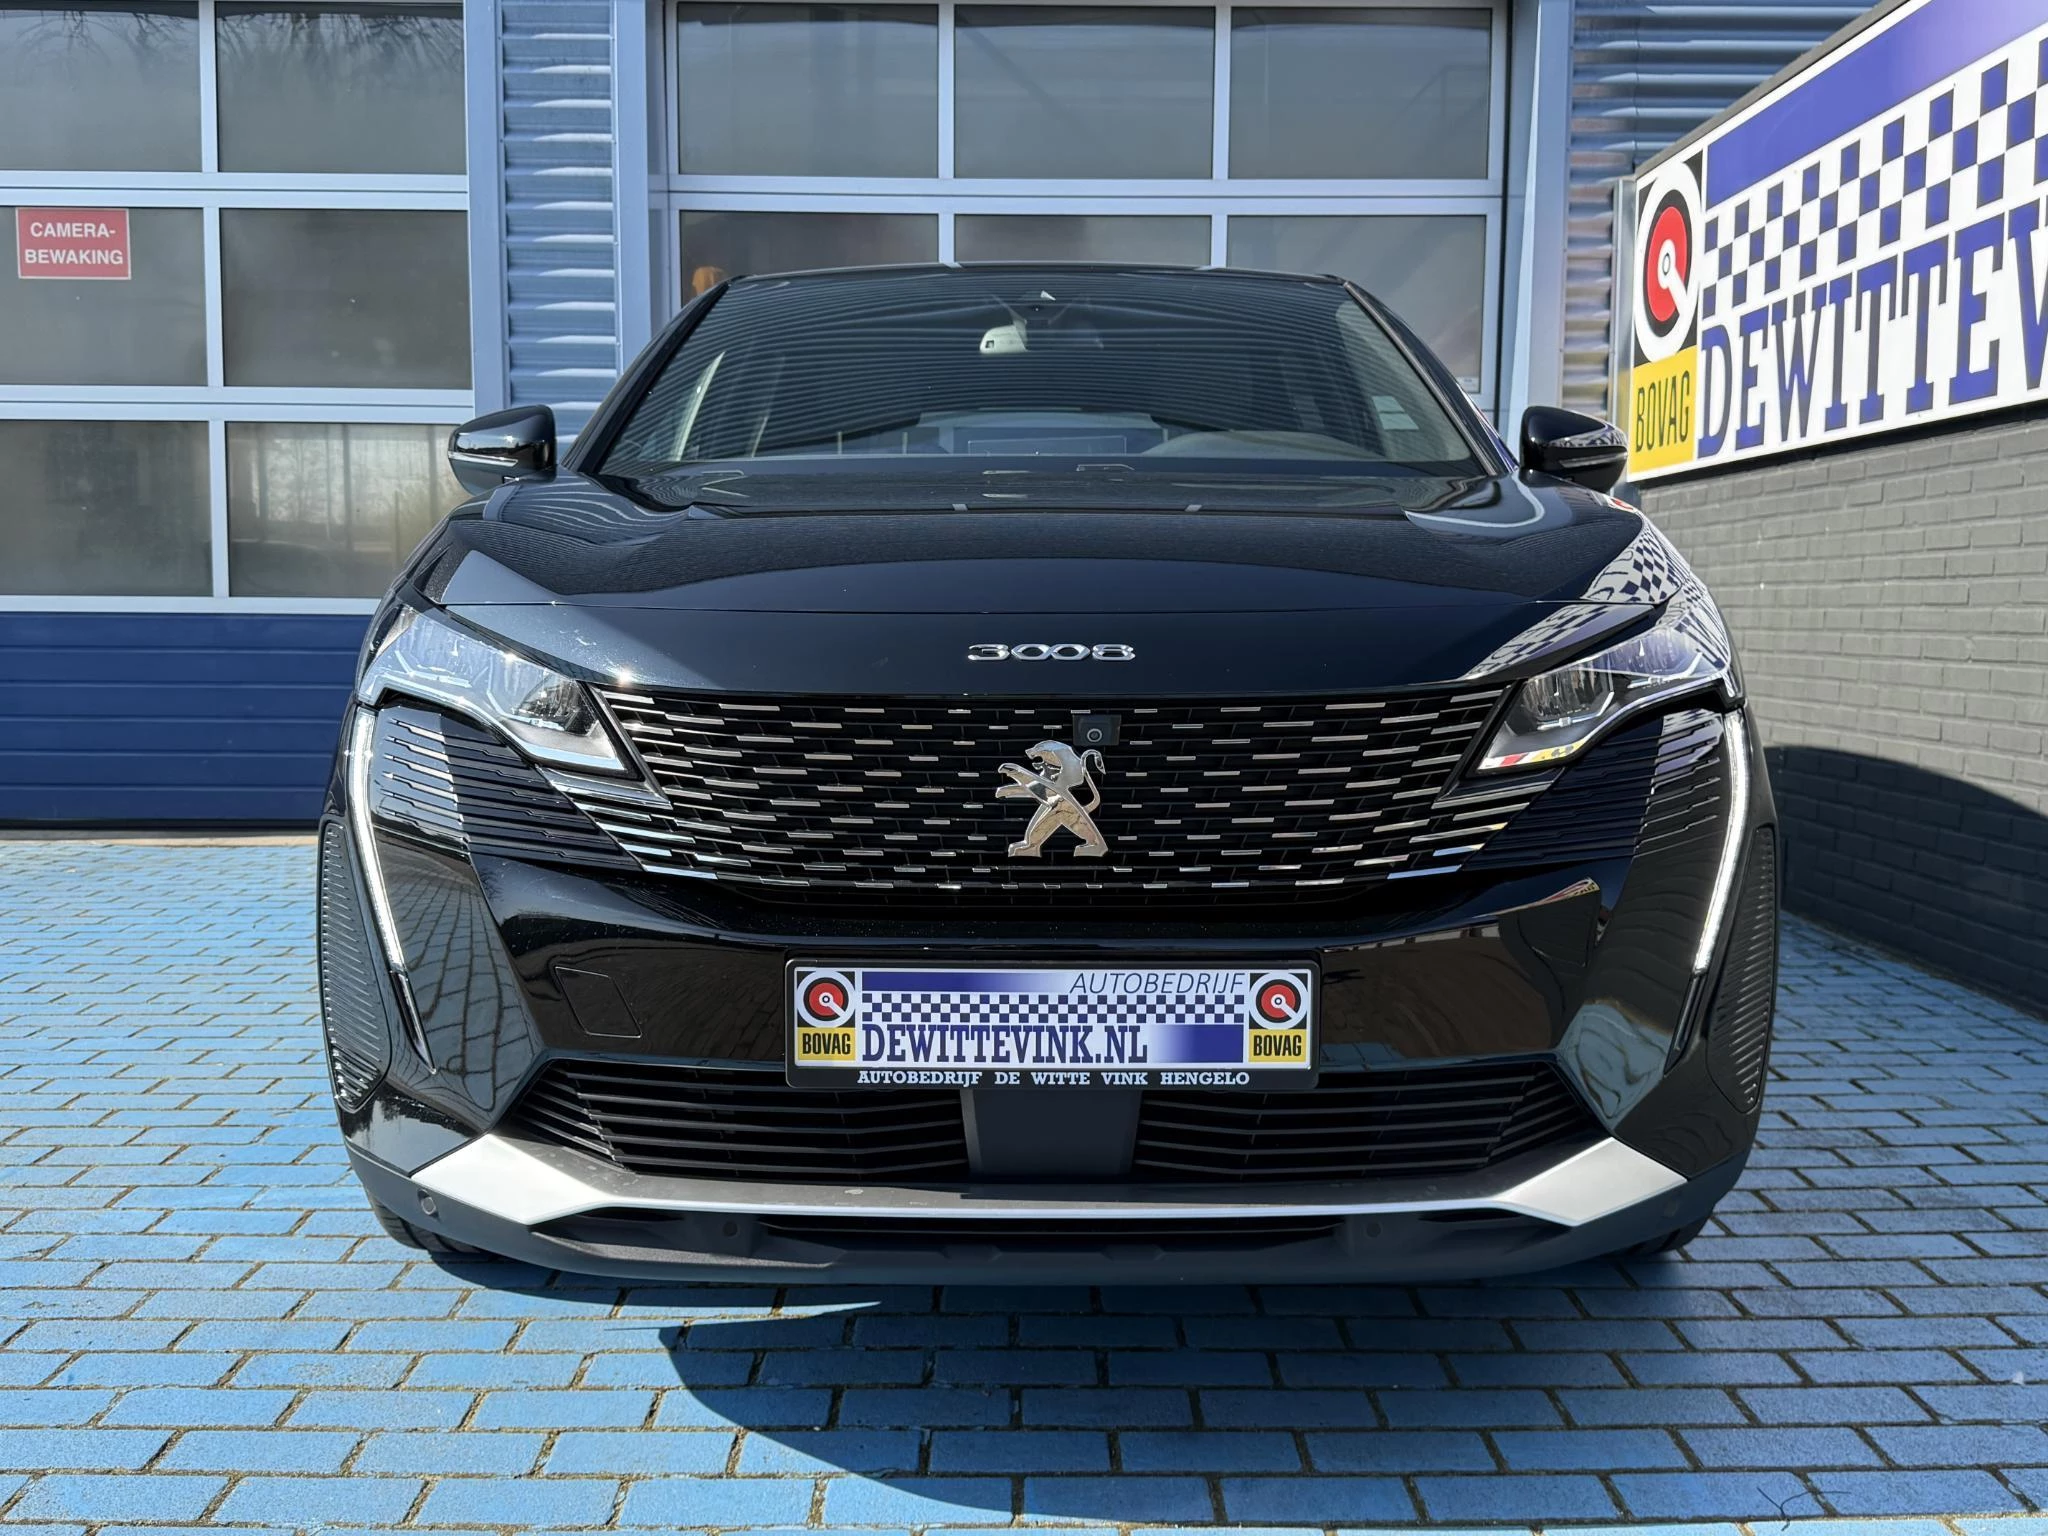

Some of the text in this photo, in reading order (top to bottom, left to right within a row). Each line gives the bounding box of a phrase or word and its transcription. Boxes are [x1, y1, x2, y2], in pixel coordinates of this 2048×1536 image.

[30, 222, 116, 238] CAMERA-
[24, 249, 124, 265] BEWAKING
[1635, 370, 1690, 452] BOVAG
[967, 643, 1136, 661] 3008
[1069, 972, 1245, 994] AUTOBEDRIJF
[802, 1032, 851, 1056] BOVAG
[862, 1024, 1148, 1064] DEWITTEVINK.NL
[1253, 1034, 1302, 1058] BOVAG
[857, 1071, 1250, 1087] AUTOBEDRIJF DE WITTE VINK HENGELO
